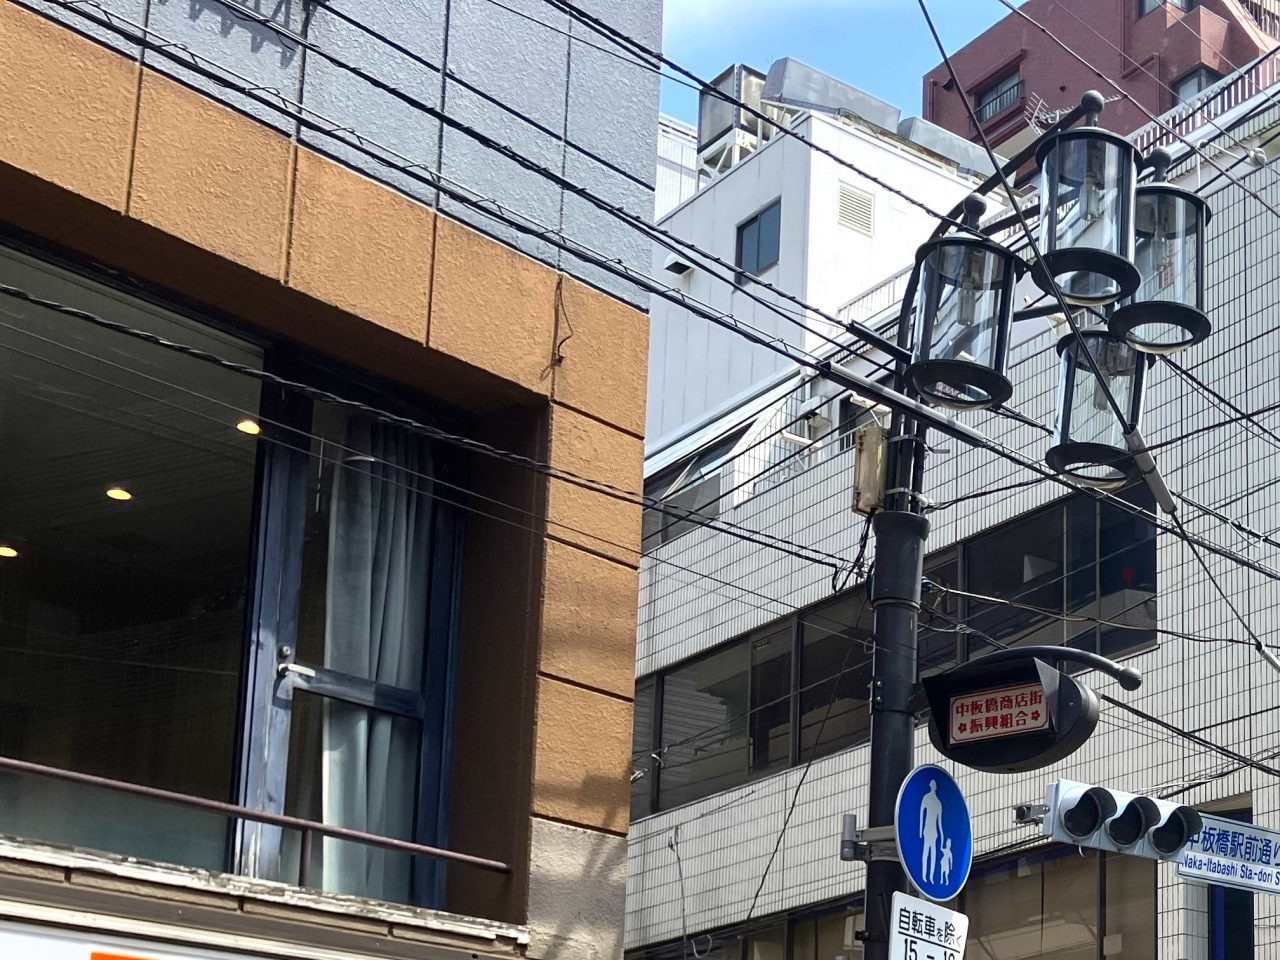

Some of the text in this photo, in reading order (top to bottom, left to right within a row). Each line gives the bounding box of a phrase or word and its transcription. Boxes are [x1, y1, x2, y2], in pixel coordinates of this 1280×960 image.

[956, 690, 1043, 717] 中板橋商店街
[969, 711, 1029, 734] 振興組合
[1183, 853, 1238, 877] Naka-Itabashi
[899, 907, 962, 948] 自転車を除く
